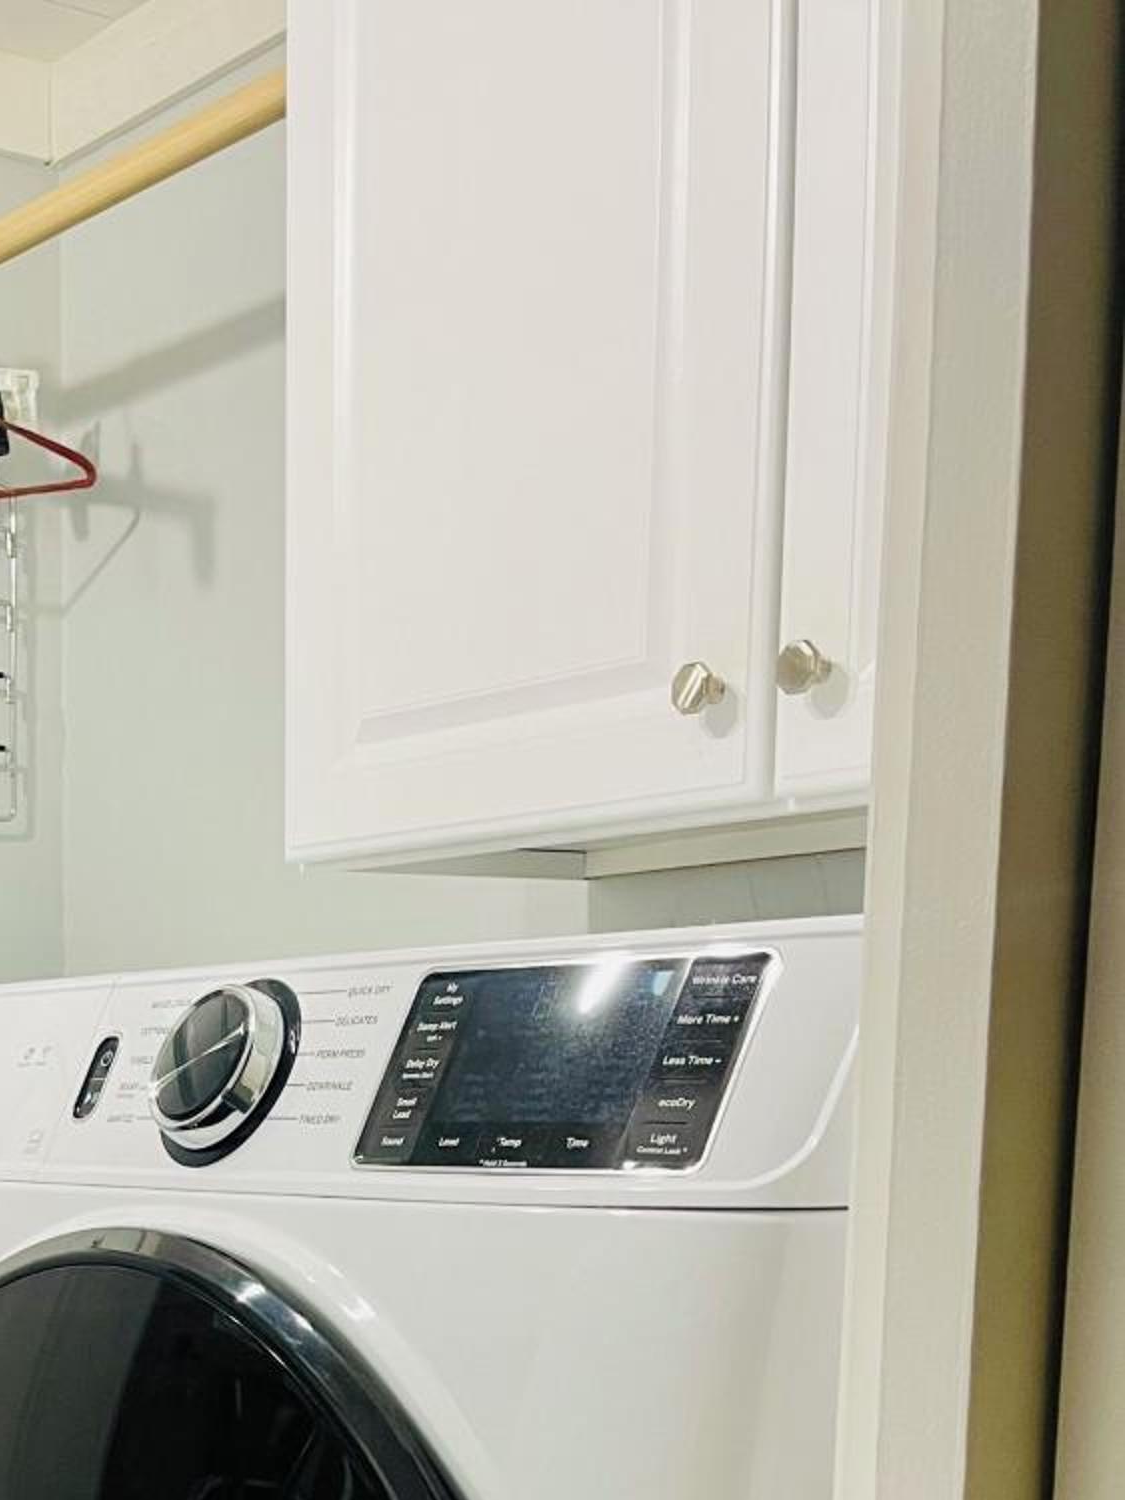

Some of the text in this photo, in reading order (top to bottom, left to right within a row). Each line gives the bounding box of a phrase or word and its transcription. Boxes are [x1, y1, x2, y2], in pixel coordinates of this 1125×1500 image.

[732, 973, 758, 985] Care
[676, 1014, 704, 1025] More
[705, 1013, 731, 1024] Time
[662, 1055, 687, 1066] Less
[688, 1055, 714, 1066] Time
[650, 1133, 677, 1146] Light
